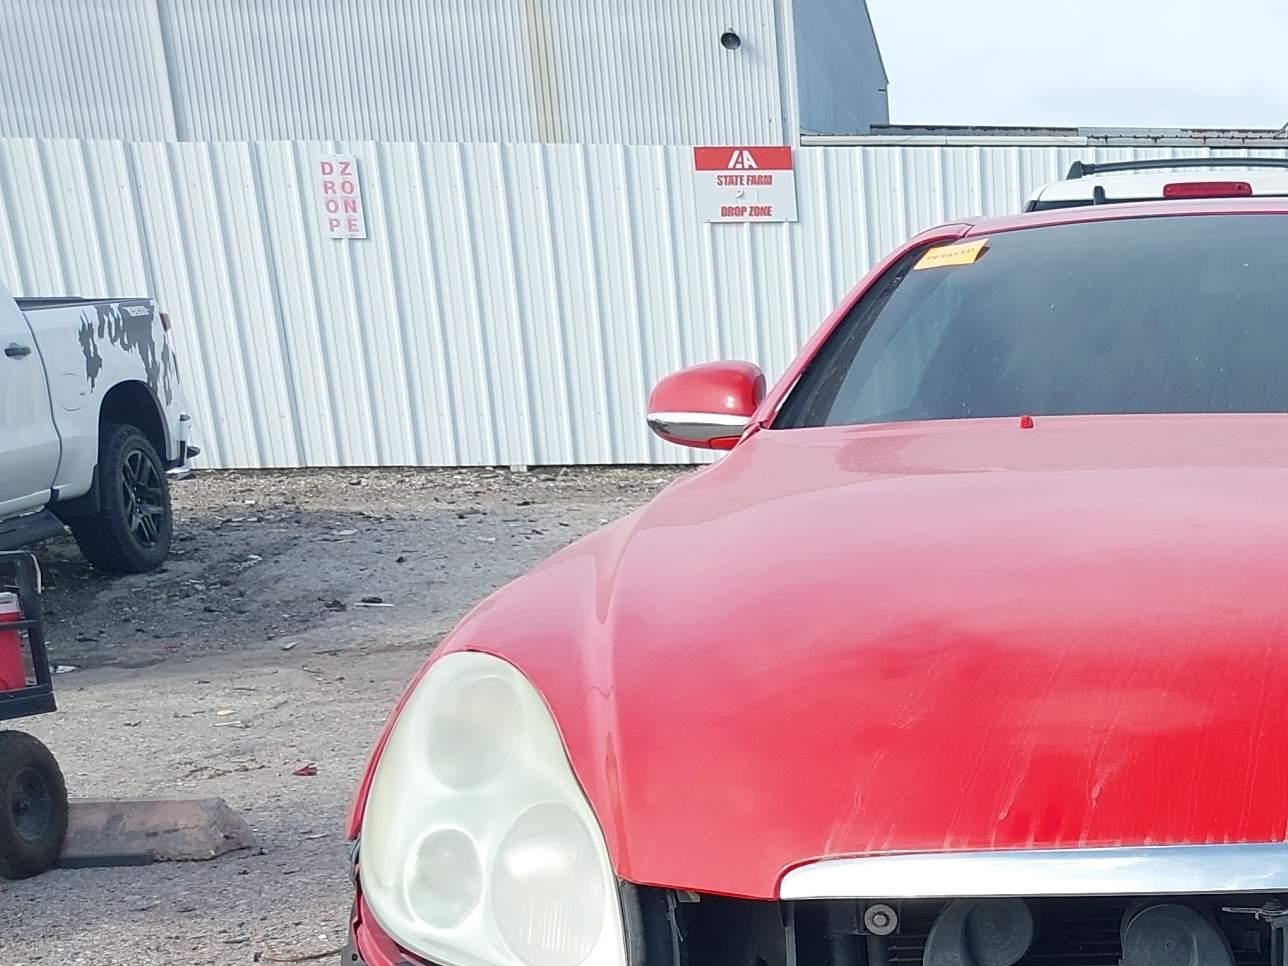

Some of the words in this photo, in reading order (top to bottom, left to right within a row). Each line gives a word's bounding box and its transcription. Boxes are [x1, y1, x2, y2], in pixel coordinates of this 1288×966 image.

[717, 175, 745, 186] STATE
[746, 175, 773, 186] FARM
[721, 206, 748, 217] DROP
[749, 206, 773, 217] ZONE
